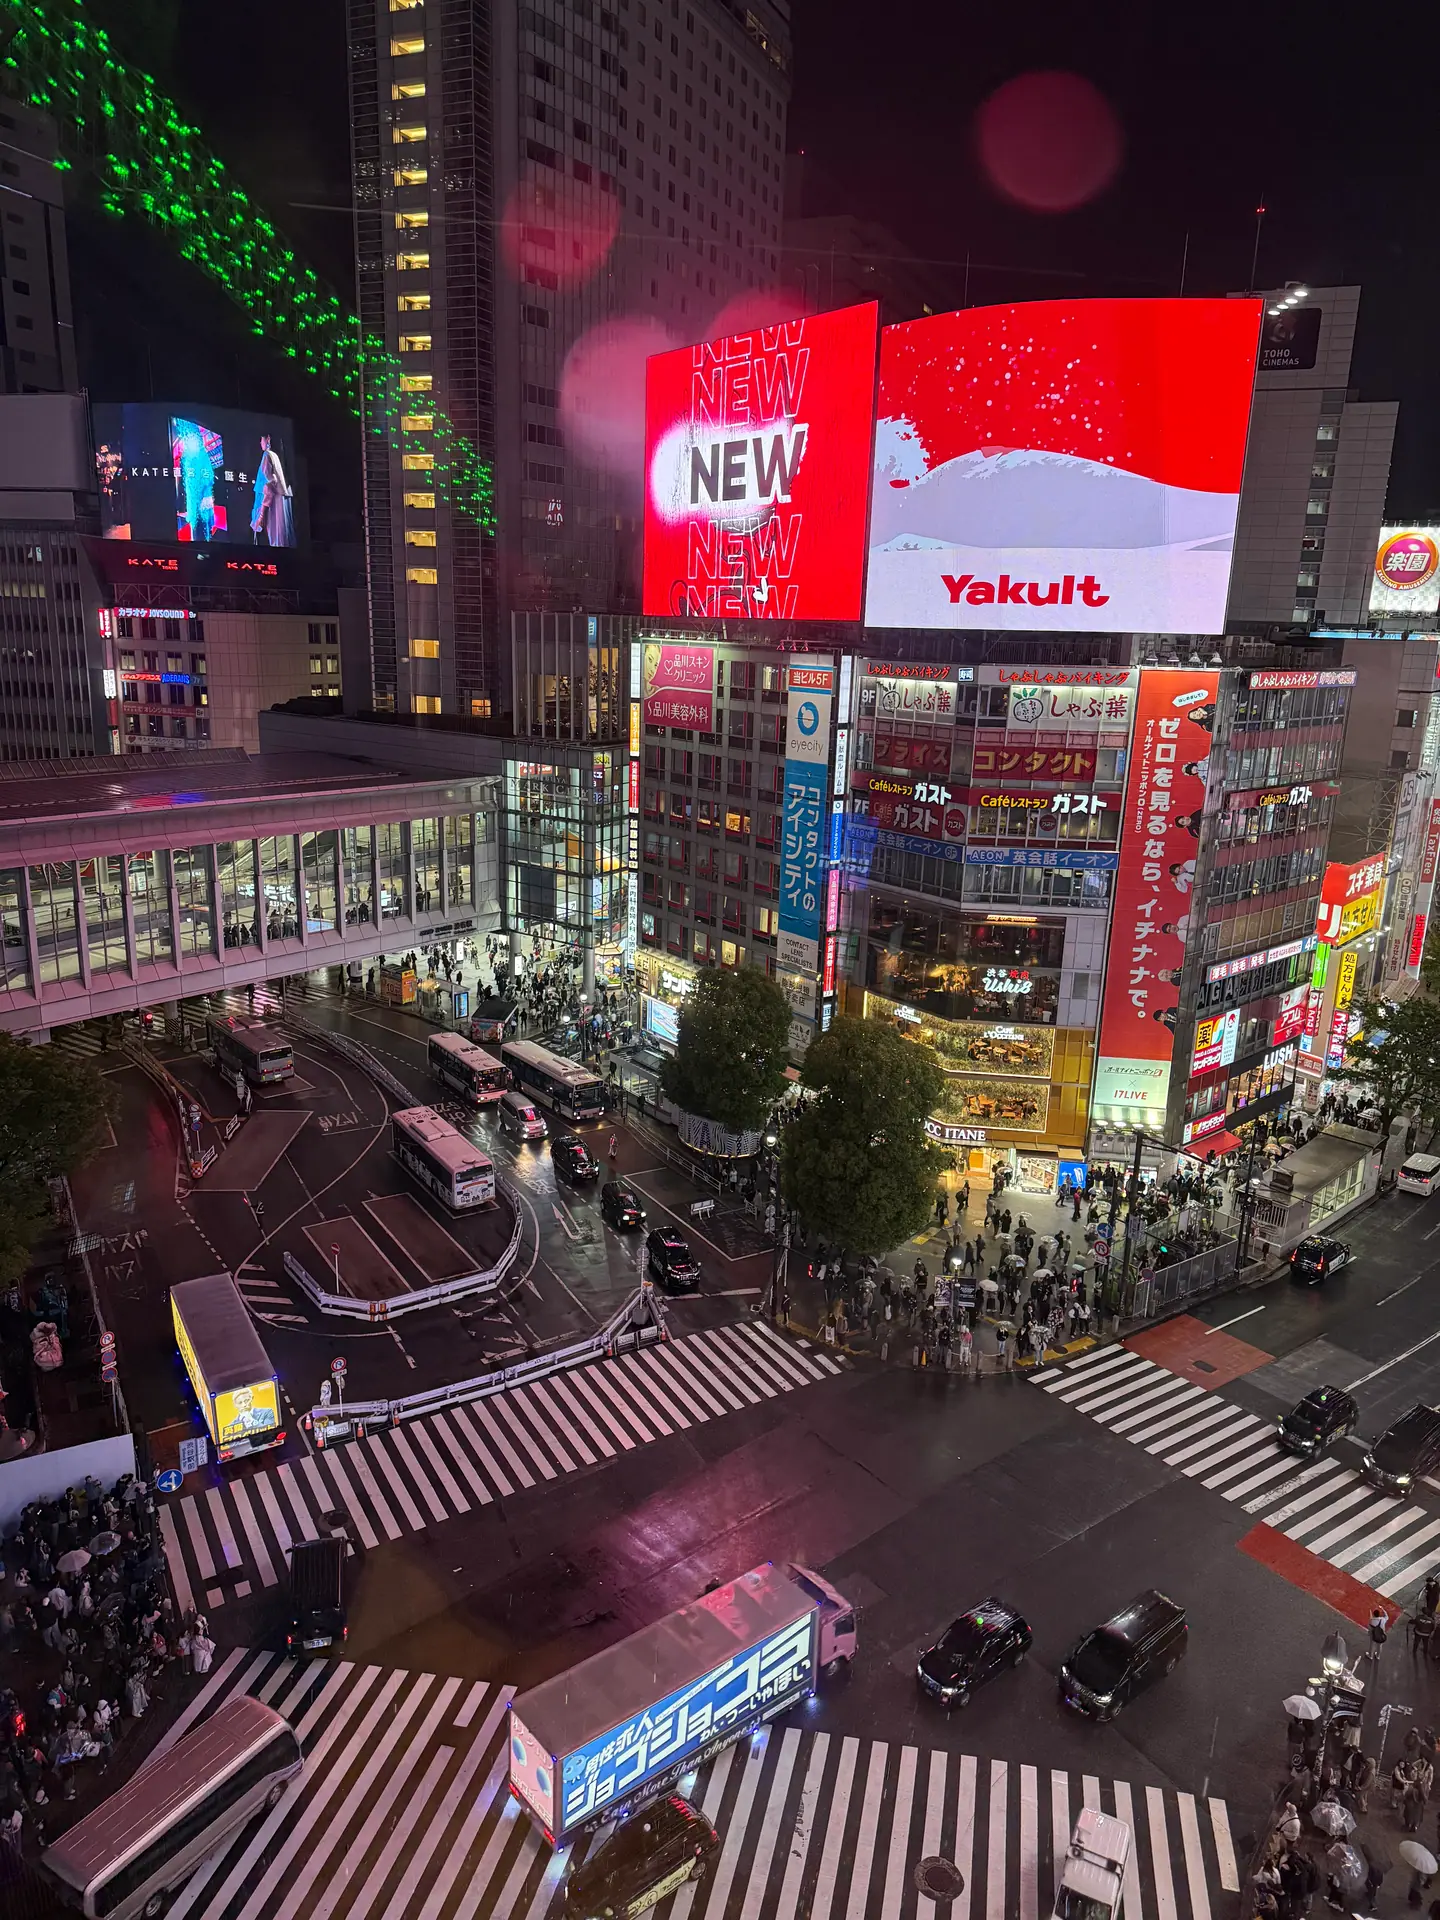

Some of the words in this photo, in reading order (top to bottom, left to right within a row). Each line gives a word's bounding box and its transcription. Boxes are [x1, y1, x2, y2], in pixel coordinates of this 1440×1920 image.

[1263, 358, 1299, 366] CINEMAS
[1264, 349, 1290, 358] TOHO
[691, 348, 811, 429] NEW
[690, 430, 806, 504] NEW
[688, 514, 803, 580] NEW
[128, 558, 178, 566] KATE
[227, 562, 277, 571] KATE
[1385, 552, 1430, 572] 楽園
[1377, 569, 1397, 589] EXCITING
[1398, 570, 1434, 590] AMUSEMENT
[940, 574, 1110, 608] Yakult
[119, 608, 147, 618] カラオケ
[149, 609, 185, 619] JOYSOUND
[673, 654, 710, 668] 品川スキン
[162, 673, 190, 685] ADERANS
[673, 671, 706, 683] クリニック
[793, 671, 829, 686] 当ビル5F
[867, 662, 951, 679] しゃぶしゃぶバイキング
[999, 668, 1130, 685] しゃぶしゃぶバイキング
[1259, 672, 1318, 687] しゃぶしゃぶバイキング
[862, 689, 877, 703] 9F
[903, 688, 951, 713] しゃぶ葉
[653, 702, 708, 724] 品川美容外科
[1051, 694, 1129, 719] しゃぶ葉
[791, 739, 824, 755] eyecity
[876, 738, 949, 766] プライス
[974, 751, 1092, 775] コンタクト
[914, 782, 952, 805] ガスト
[1289, 786, 1313, 806] ガスト
[854, 798, 870, 814] 7F
[980, 795, 1048, 809] Caféレストラン
[1051, 793, 1107, 814] ガスト
[893, 803, 938, 832] ガスト
[947, 820, 963, 829] ガスト
[784, 783, 806, 907] アイシティ
[803, 787, 821, 911] コンタクトの
[878, 831, 941, 854] 英会話イーオン
[971, 850, 1004, 862] AEON
[1013, 851, 1114, 866] 英会話イーオン
[1128, 718, 1181, 1018] ゼロを見るなら、イチナナで。
[1346, 861, 1383, 897] スギ薬局
[786, 938, 809, 952] CONTACT
[1304, 935, 1318, 950] 4F
[781, 953, 813, 969] SPECIALISTS
[791, 948, 804, 958] LENS
[662, 970, 694, 996] サンド
[982, 977, 1033, 994] Ushi8
[1281, 1008, 1301, 1028] アコム
[1198, 1024, 1211, 1048] 薬
[1193, 1054, 1222, 1070] サンドラッグ
[1264, 1043, 1293, 1071] LUSH
[1114, 1090, 1148, 1100] 17LIVE
[1201, 1113, 1225, 1130] サンドラッグ
[945, 1128, 986, 1141] ITANE
[585, 1710, 654, 1779] 男性求人
[634, 1777, 670, 1803] More
[671, 1756, 702, 1780] Than
